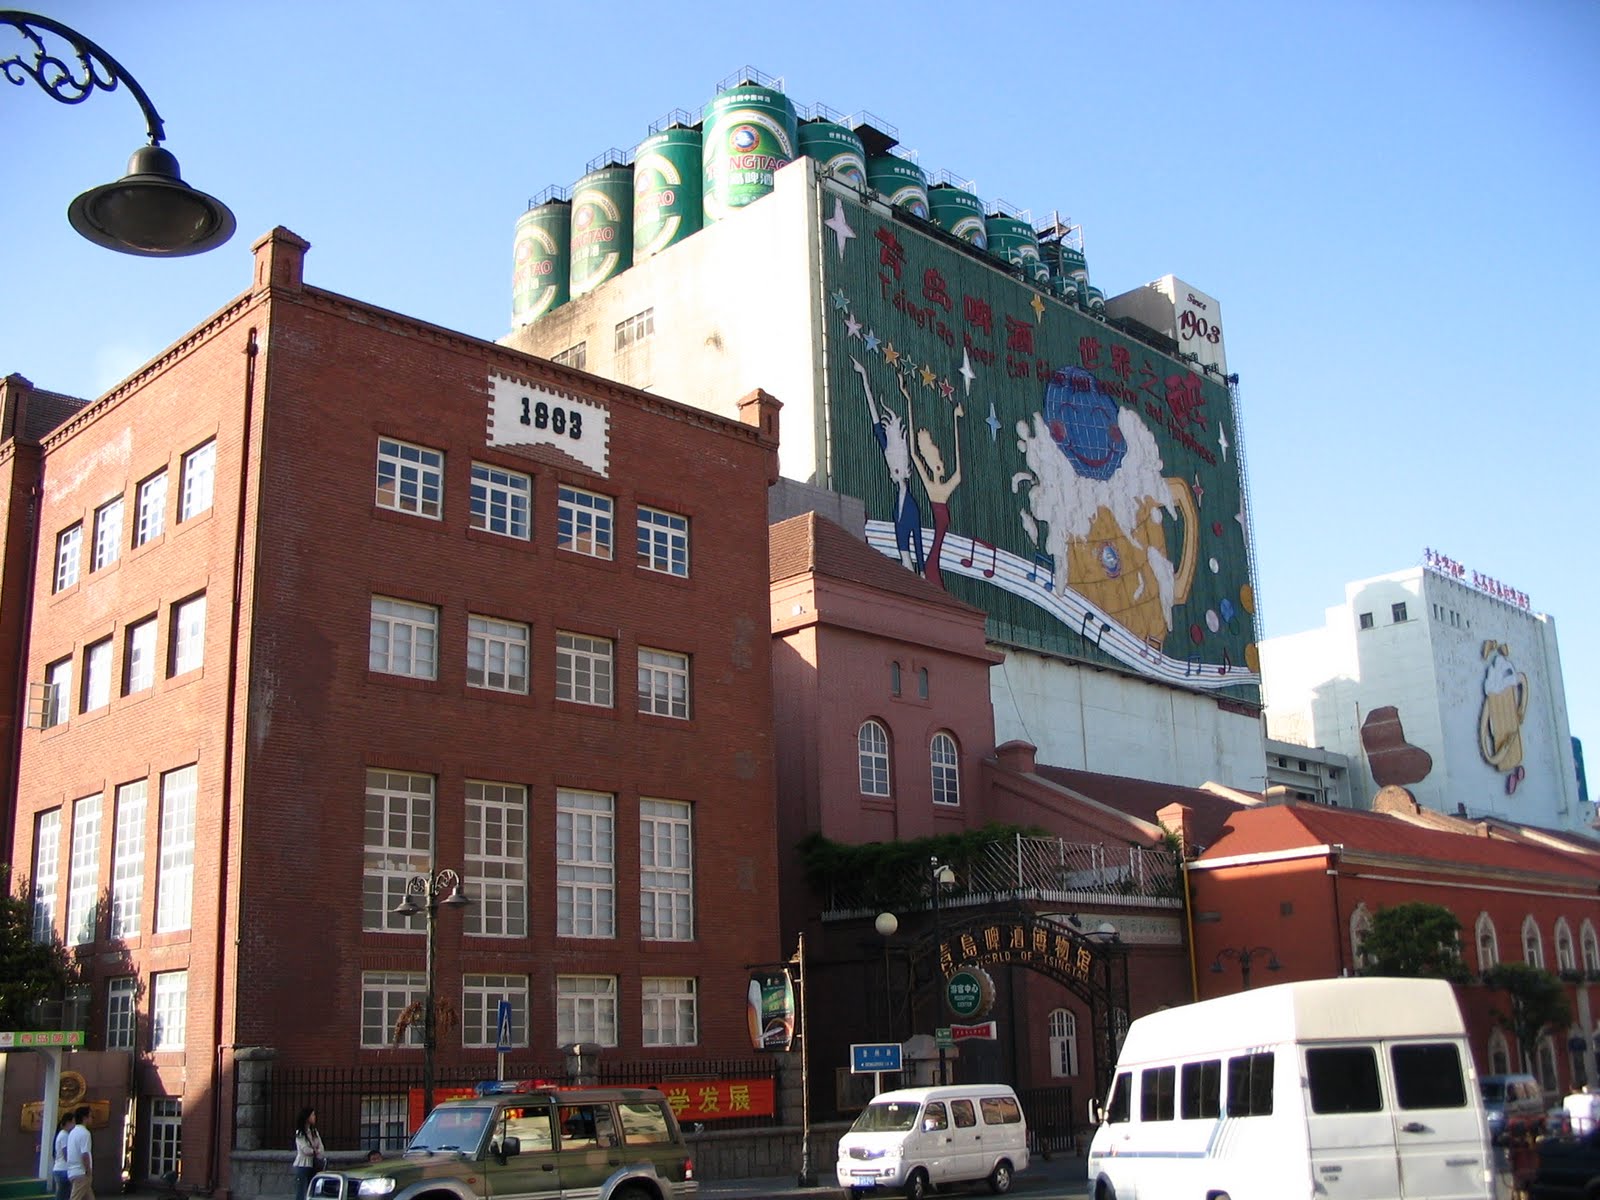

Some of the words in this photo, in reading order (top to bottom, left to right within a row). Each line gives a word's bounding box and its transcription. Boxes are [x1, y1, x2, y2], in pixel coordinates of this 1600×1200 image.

[1177, 310, 1220, 344] 1903
[520, 397, 582, 440] 1903
[1021, 951, 1033, 961] OF
[668, 1084, 751, 1117] 学发展
